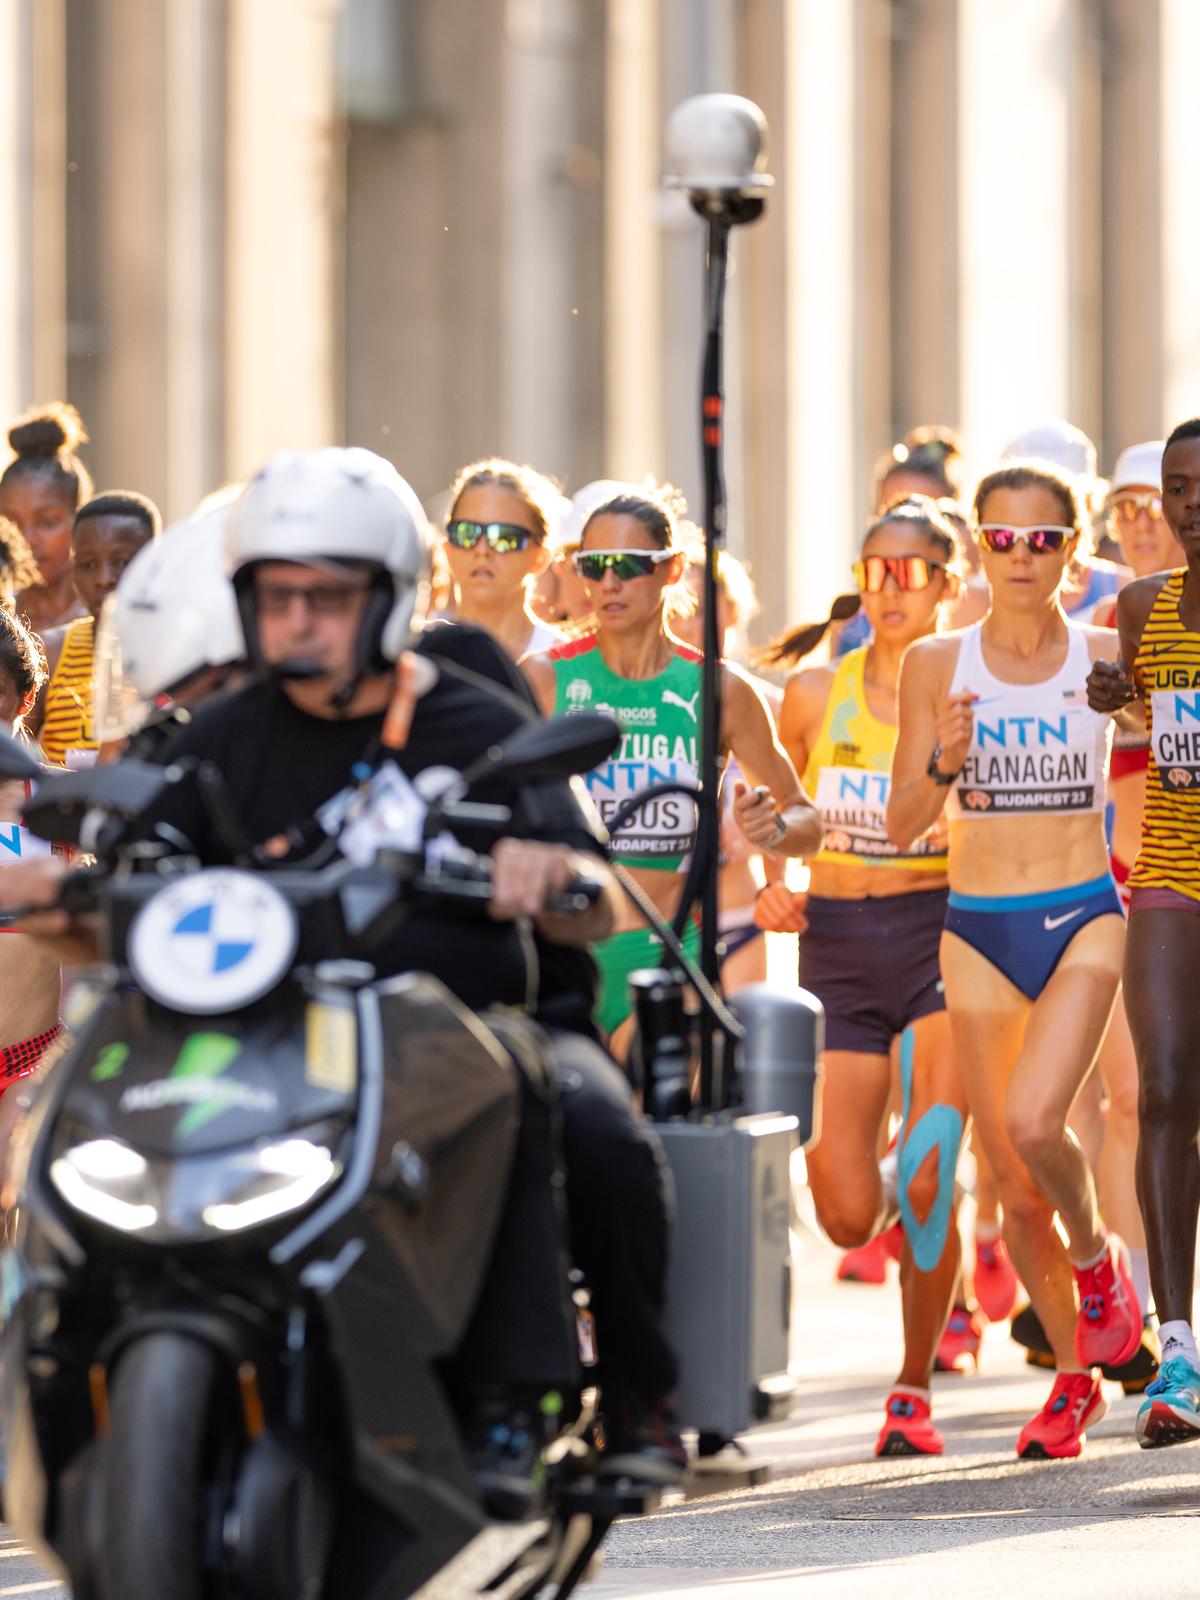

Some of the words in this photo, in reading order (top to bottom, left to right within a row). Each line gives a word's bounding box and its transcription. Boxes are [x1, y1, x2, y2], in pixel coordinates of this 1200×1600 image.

[977, 715, 1068, 749] NTN
[961, 752, 1088, 785] FLANAGAN
[840, 774, 890, 803] NT
[994, 791, 1068, 808] BUDAPEST
[596, 799, 680, 829] ESUS
